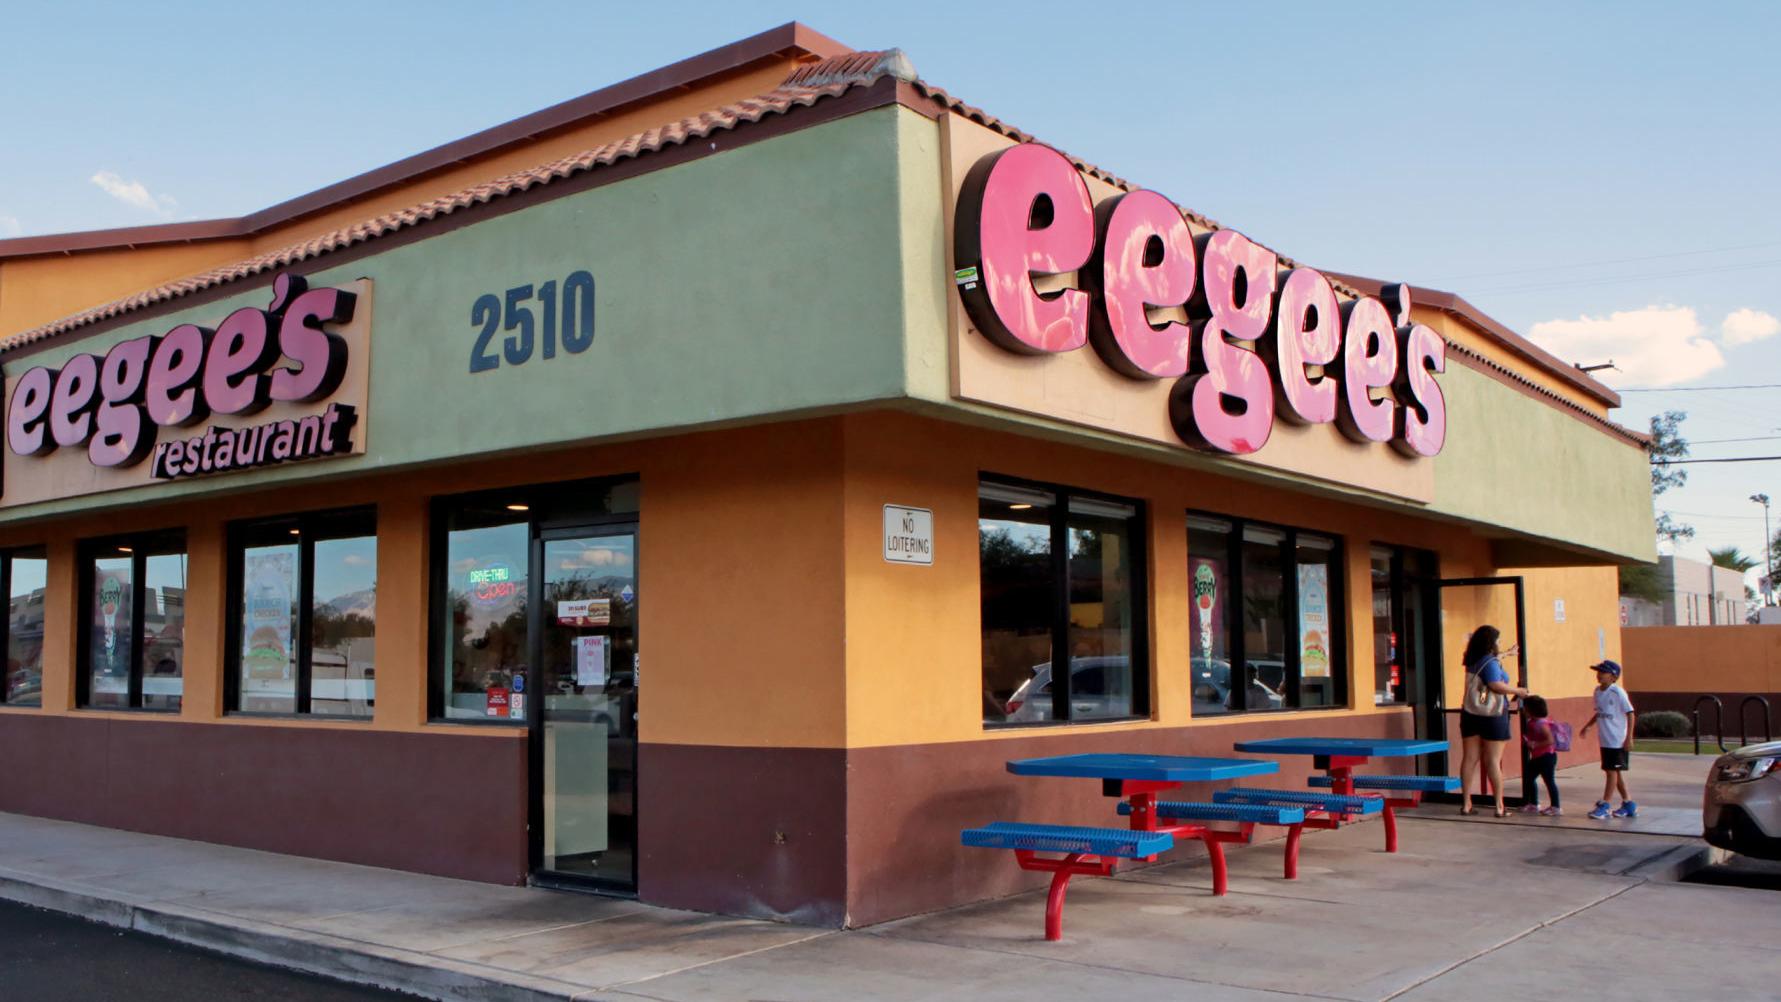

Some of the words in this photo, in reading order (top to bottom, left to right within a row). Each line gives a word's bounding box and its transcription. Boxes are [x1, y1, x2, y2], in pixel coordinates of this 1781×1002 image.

[469, 270, 596, 374] 2510
[958, 142, 1446, 456] eegee's
[8, 272, 356, 467] eegee's
[151, 403, 350, 479] restaurant
[887, 535, 930, 554] LOITERING
[902, 518, 914, 534] NO
[470, 568, 509, 583] DRIVE-THRU
